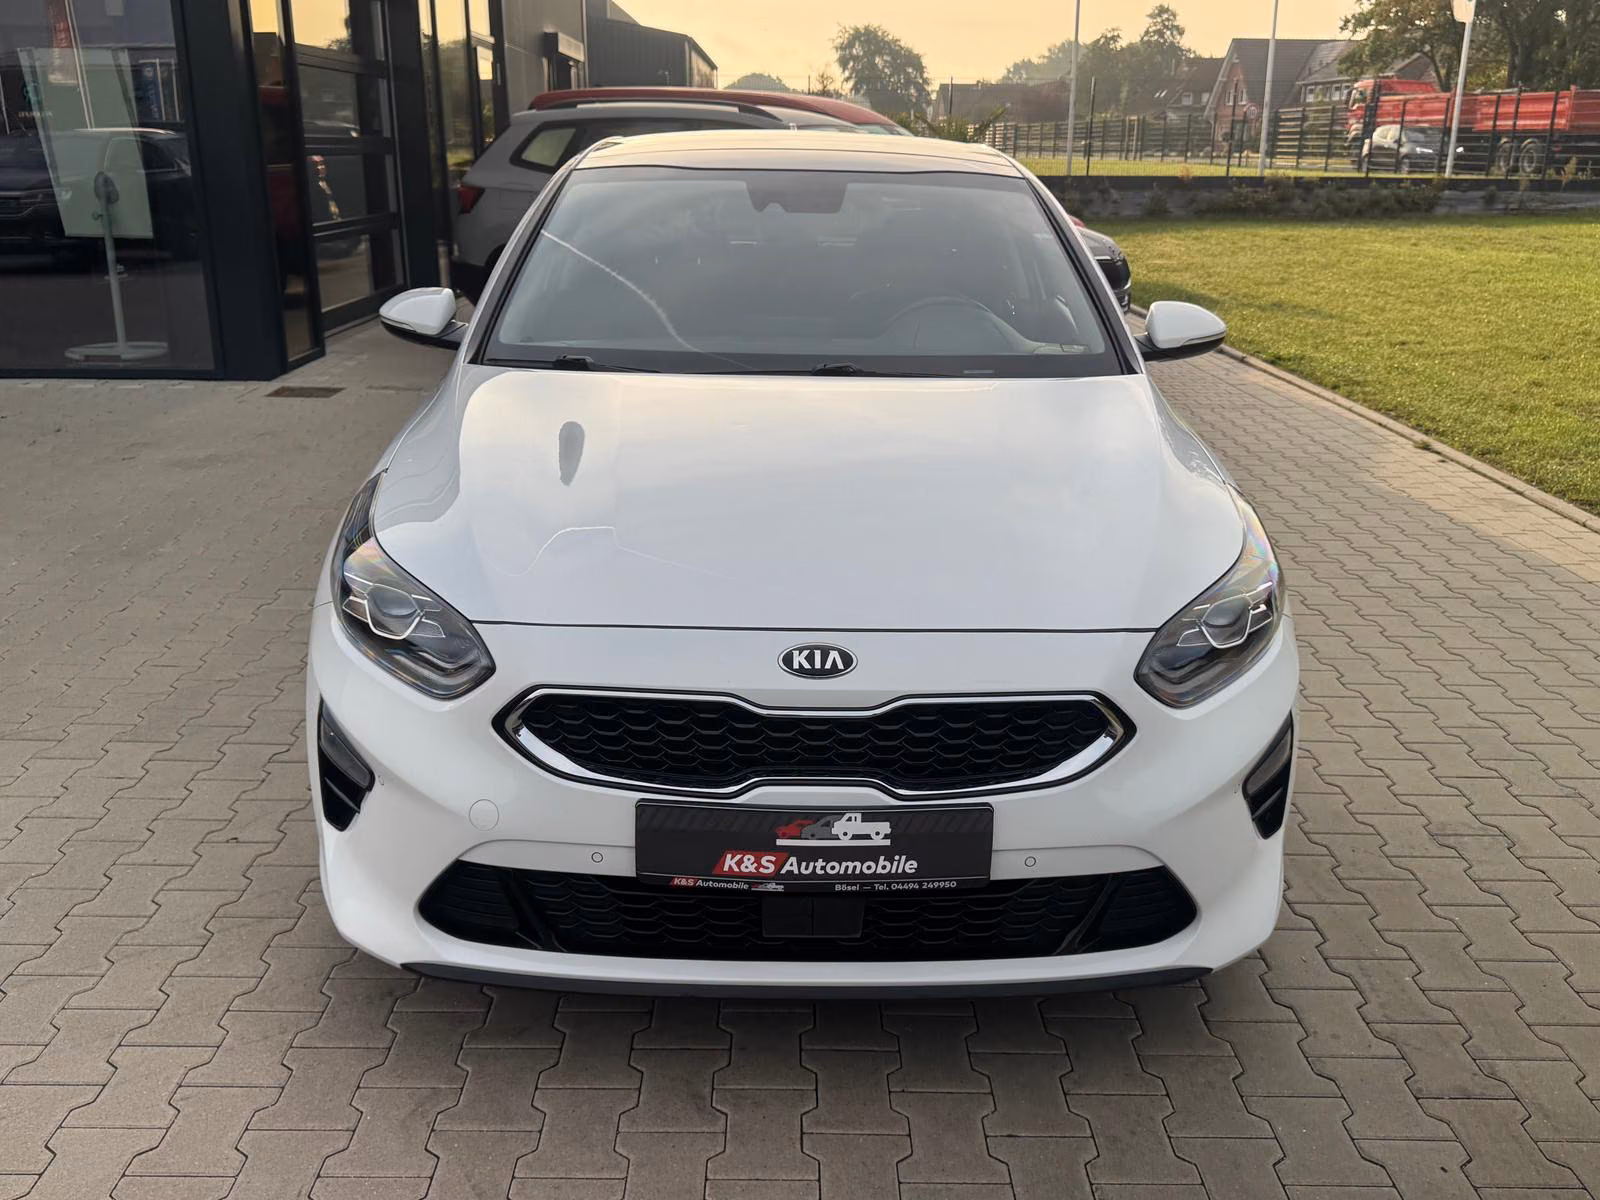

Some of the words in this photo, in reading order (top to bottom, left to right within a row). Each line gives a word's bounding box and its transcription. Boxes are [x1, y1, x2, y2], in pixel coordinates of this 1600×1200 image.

[791, 649, 845, 670] KIA
[723, 853, 777, 874] K&S
[780, 855, 918, 875] Automobile
[673, 877, 695, 887] K&S
[695, 879, 750, 890] Automobile
[834, 883, 860, 892] Bösel
[874, 883, 889, 891] Tel.
[891, 883, 920, 891] 04494
[922, 881, 957, 890] 249950
